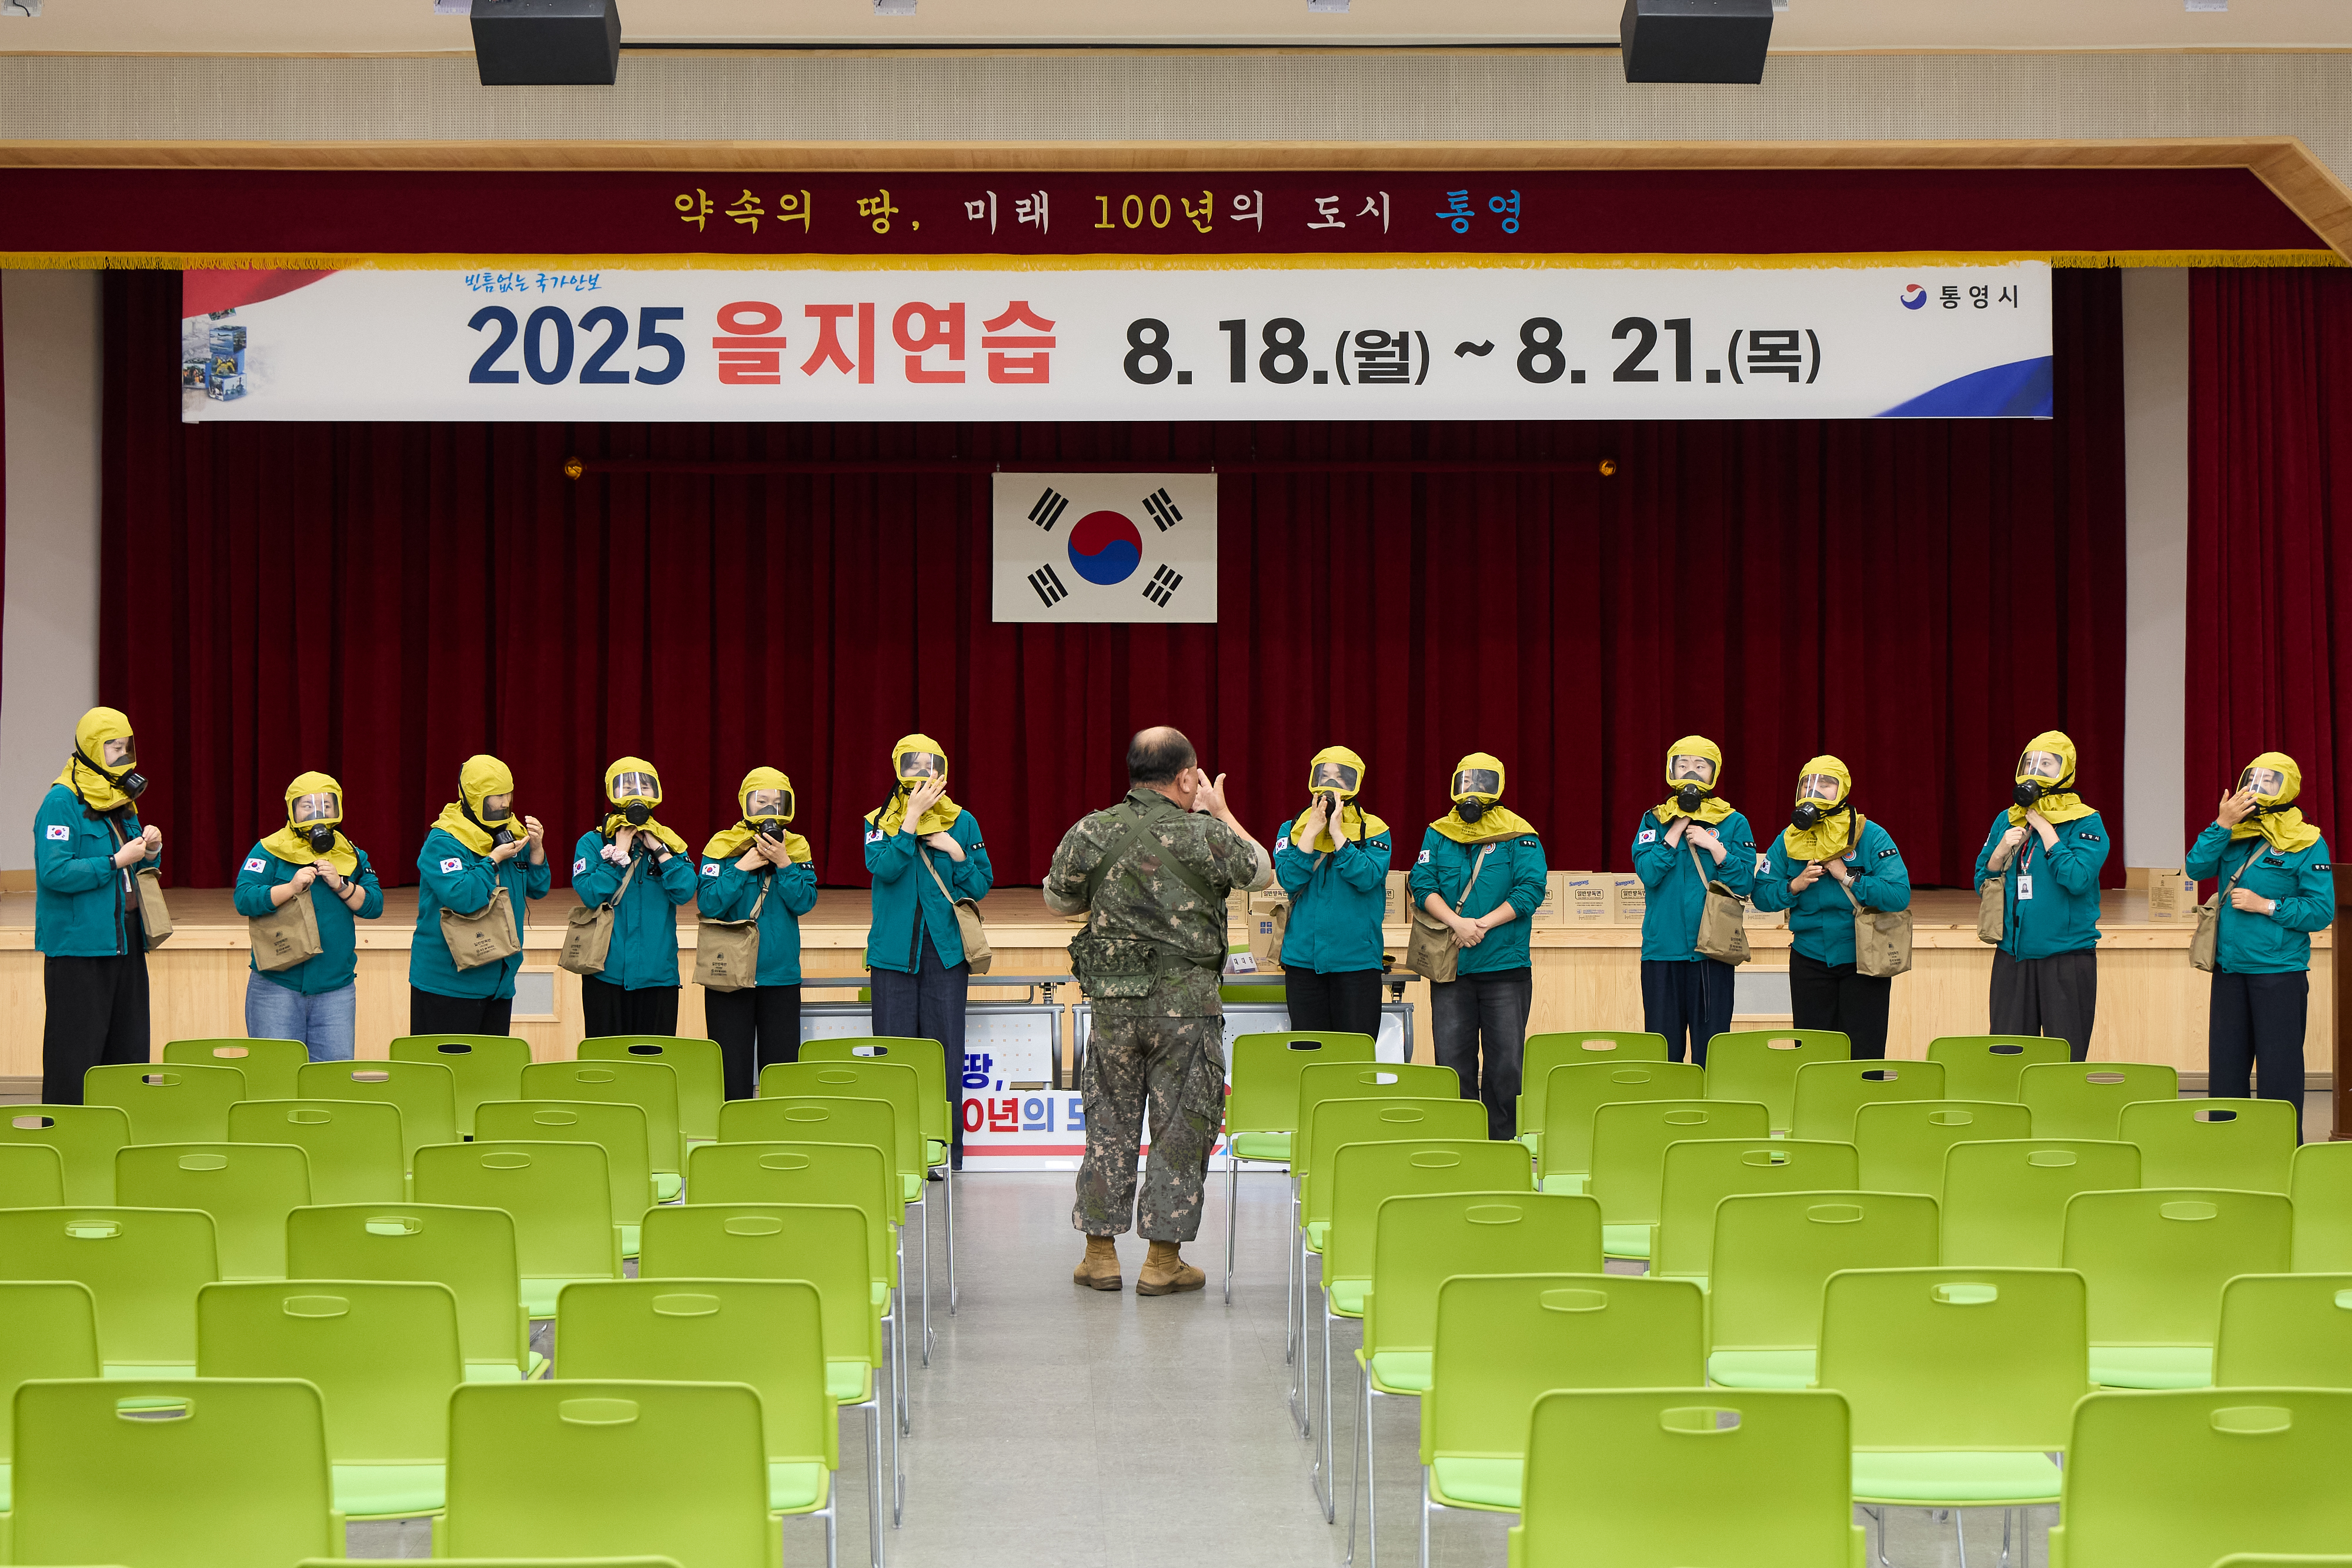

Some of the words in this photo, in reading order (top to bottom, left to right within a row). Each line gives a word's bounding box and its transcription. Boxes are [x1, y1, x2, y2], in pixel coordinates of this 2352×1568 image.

[674, 188, 811, 234] 약속의
[856, 189, 920, 234] 땅,
[964, 190, 1048, 235] 미래
[1094, 190, 1263, 233] 100년의
[1307, 191, 1389, 235] 도시
[1435, 189, 1520, 234] 통영
[465, 272, 529, 293] 빈틈없는
[535, 272, 602, 294] 국가안보
[1939, 285, 2017, 309] 통영시
[469, 306, 686, 385] 2025
[712, 300, 1056, 385] 을지연습
[1123, 317, 1192, 385] 8.
[1516, 317, 1586, 384] 8.
